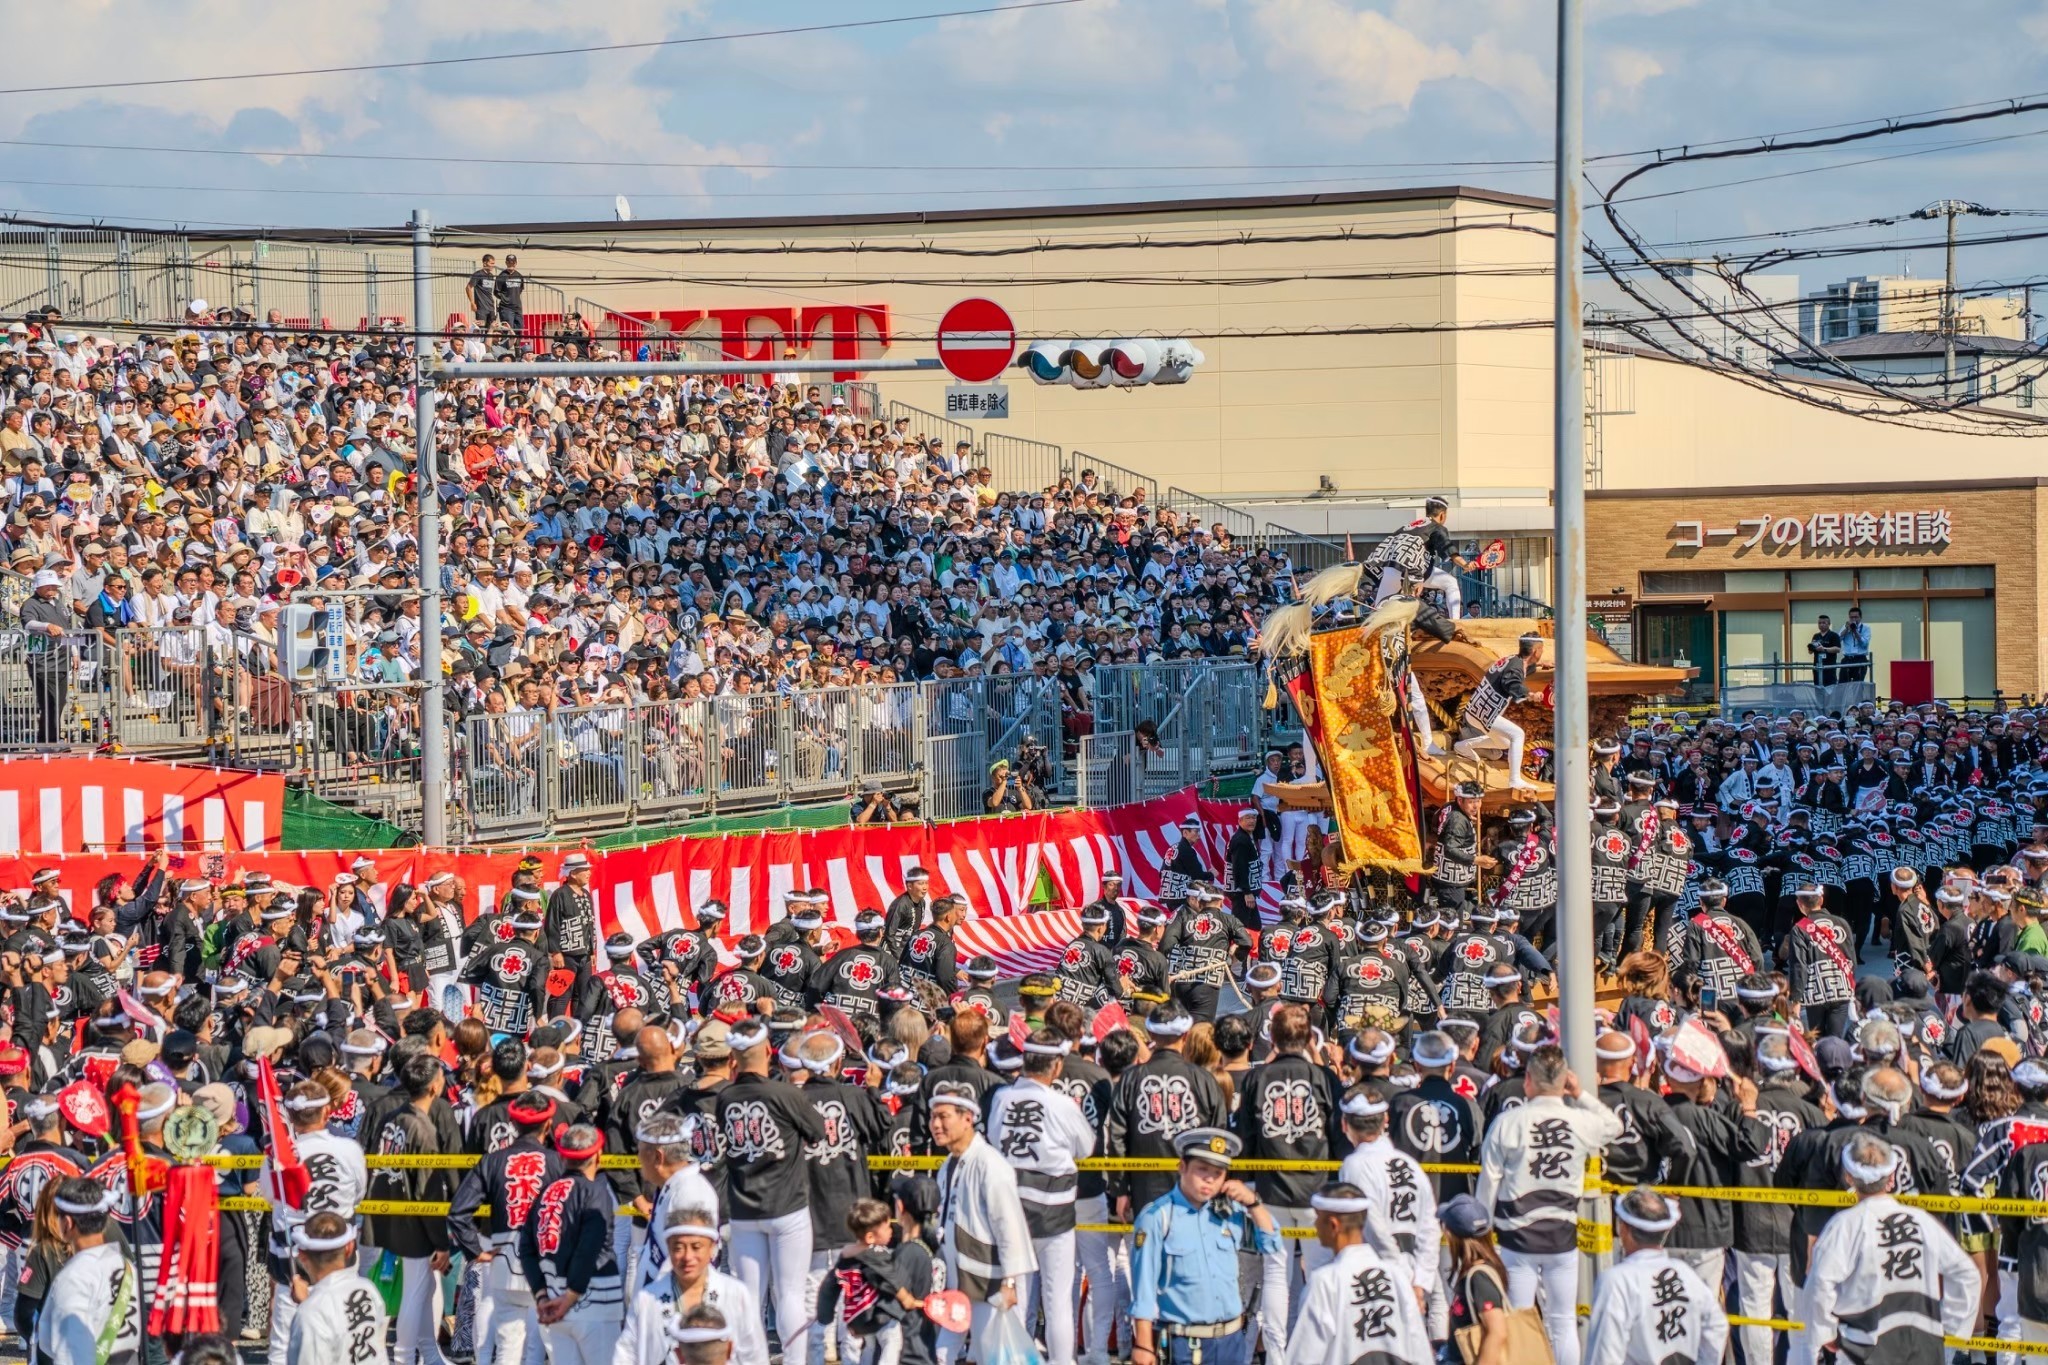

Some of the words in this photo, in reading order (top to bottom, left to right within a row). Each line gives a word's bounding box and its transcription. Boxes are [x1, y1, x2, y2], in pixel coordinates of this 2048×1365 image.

[948, 393, 1005, 411] 自転車を除く
[1676, 509, 1952, 548] コープの保険相談
[1001, 1099, 1044, 1162] 並松
[1529, 1118, 1574, 1180] 並松
[416, 1157, 434, 1167] KEEP
[435, 1157, 451, 1167] OUT
[883, 1158, 902, 1168] KEEP
[904, 1158, 920, 1168] OUT
[1384, 1157, 1418, 1223] 並松
[1720, 1190, 1742, 1198] KEEP
[1837, 1195, 1857, 1204] OUT
[1980, 1202, 2000, 1211] OUT
[2001, 1203, 2025, 1212] KEEP
[1876, 1213, 1922, 1281] 並松
[1351, 1267, 1397, 1341] 並松
[1651, 1267, 1689, 1344] 並松
[1988, 1341, 2012, 1349] KEEP
